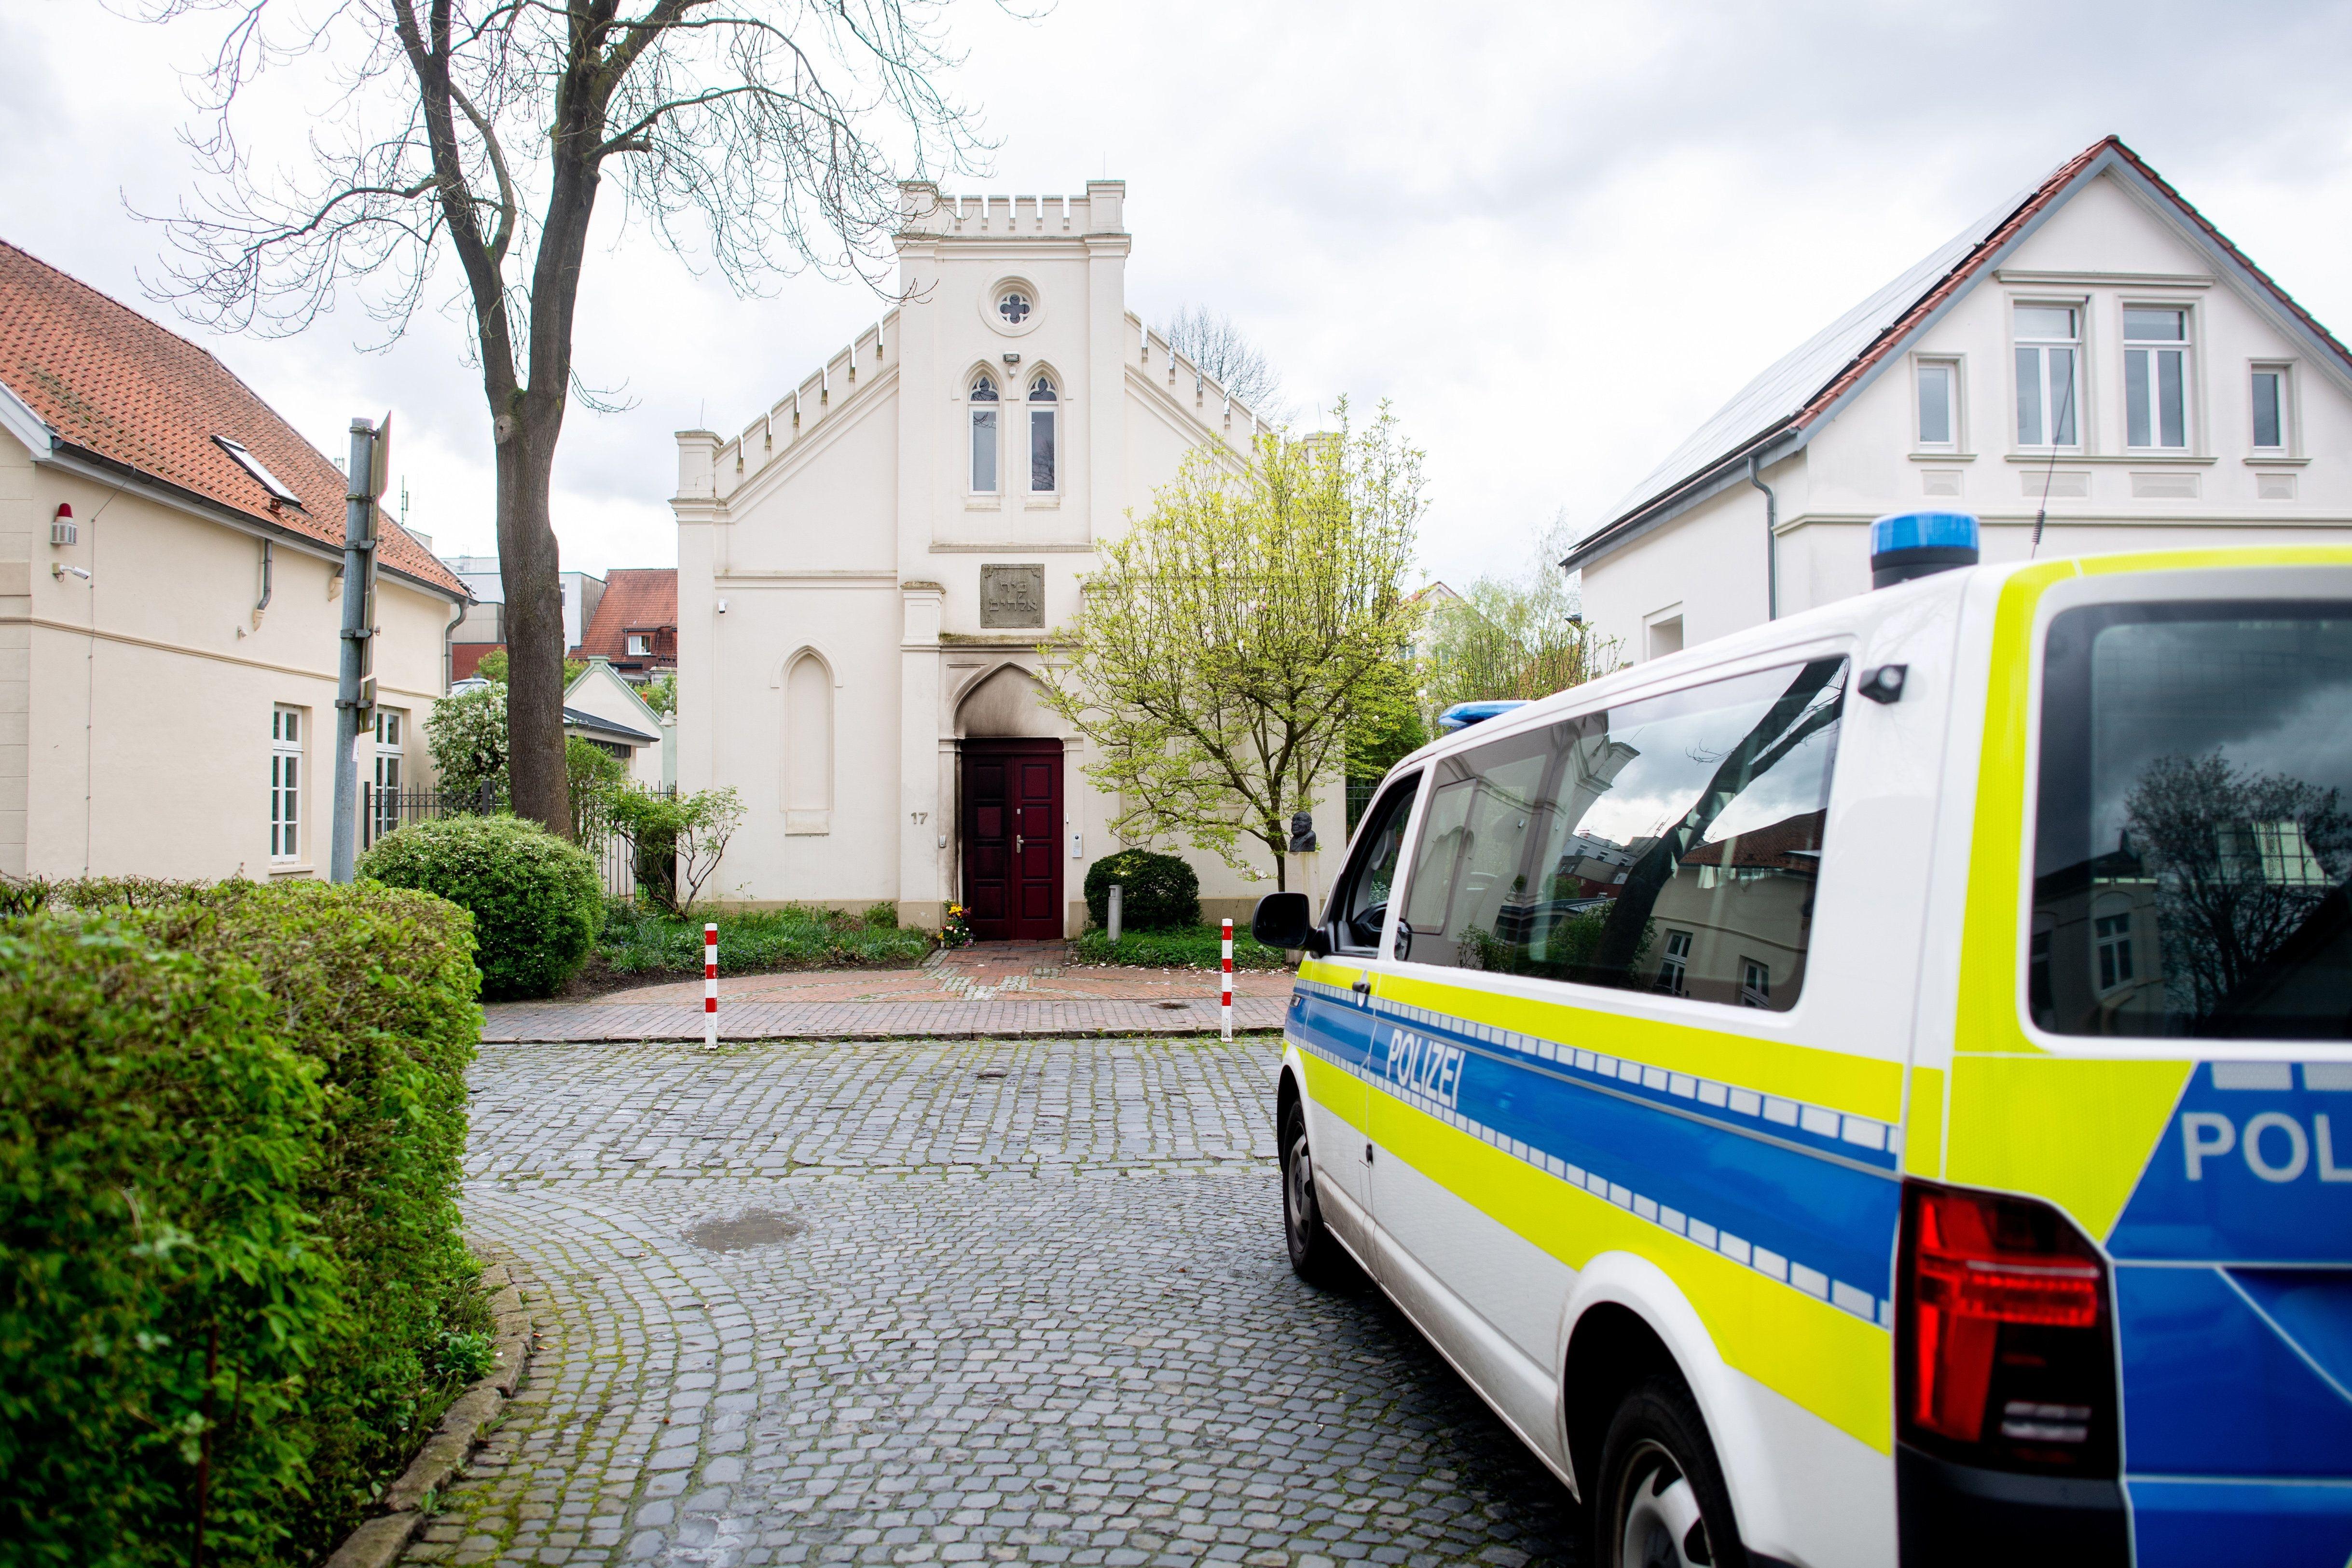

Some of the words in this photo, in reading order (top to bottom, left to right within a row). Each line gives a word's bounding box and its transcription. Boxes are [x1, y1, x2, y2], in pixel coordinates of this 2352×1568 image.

[911, 812, 928, 825] 17
[1386, 1028, 1466, 1111] POLIZEI
[2181, 1111, 2352, 1183] POL
